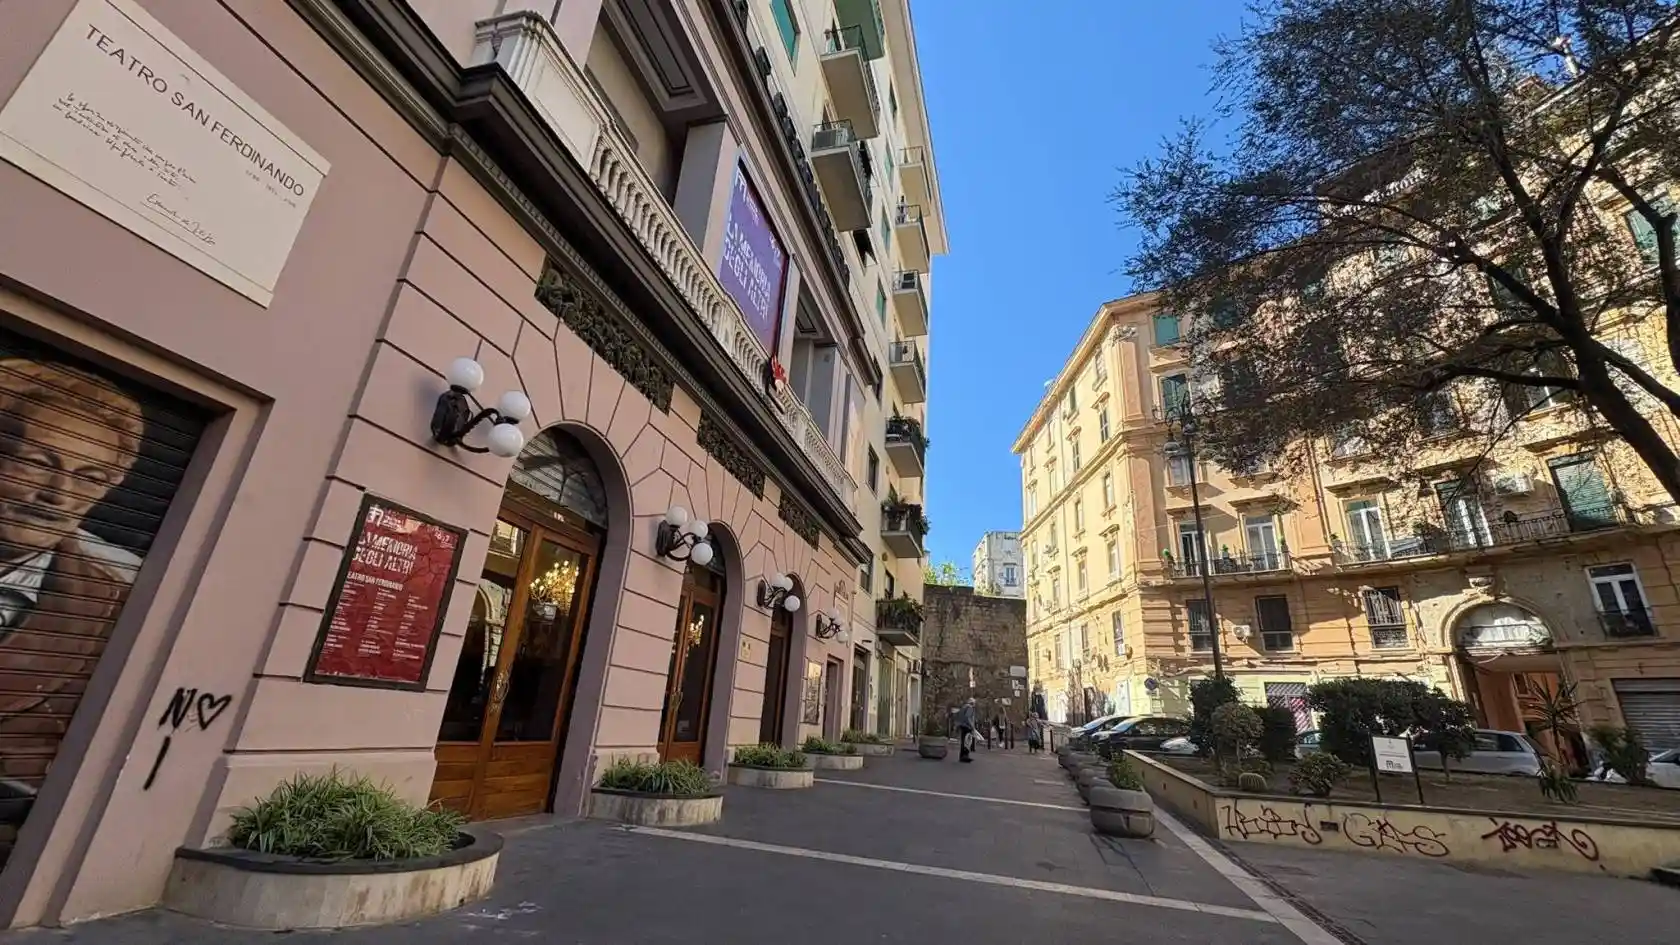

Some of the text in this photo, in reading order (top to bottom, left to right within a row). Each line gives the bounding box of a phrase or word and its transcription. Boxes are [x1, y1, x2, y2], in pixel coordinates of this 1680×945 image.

[84, 23, 168, 94] TEATRO
[170, 91, 210, 126] SAN
[210, 121, 305, 197] FERDINANDO
[724, 236, 748, 290] DEGLI
[748, 277, 770, 323] ALTRI
[384, 555, 415, 576] ALTRI
